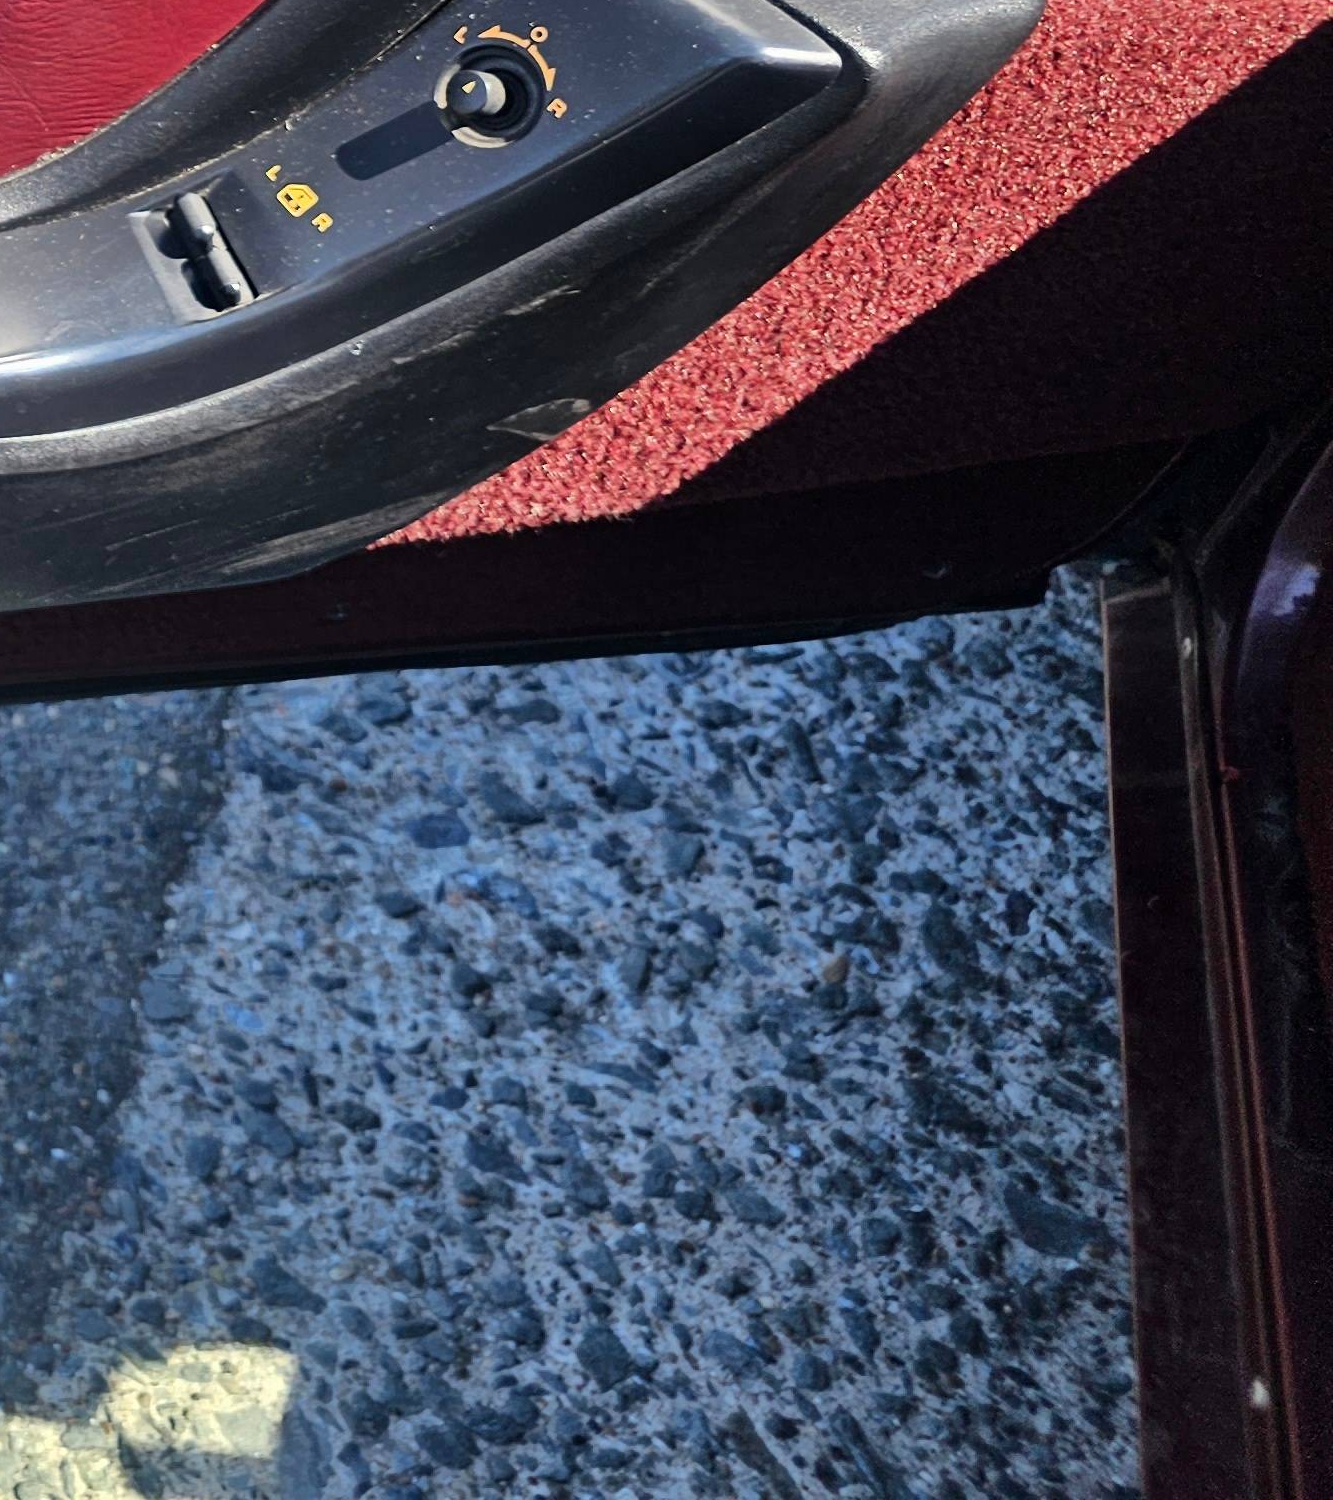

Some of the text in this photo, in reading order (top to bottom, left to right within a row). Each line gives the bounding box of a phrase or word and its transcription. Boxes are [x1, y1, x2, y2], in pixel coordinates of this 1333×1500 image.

[454, 26, 468, 44] L
[547, 98, 568, 119] R
[266, 165, 282, 181] L
[311, 212, 334, 233] R
